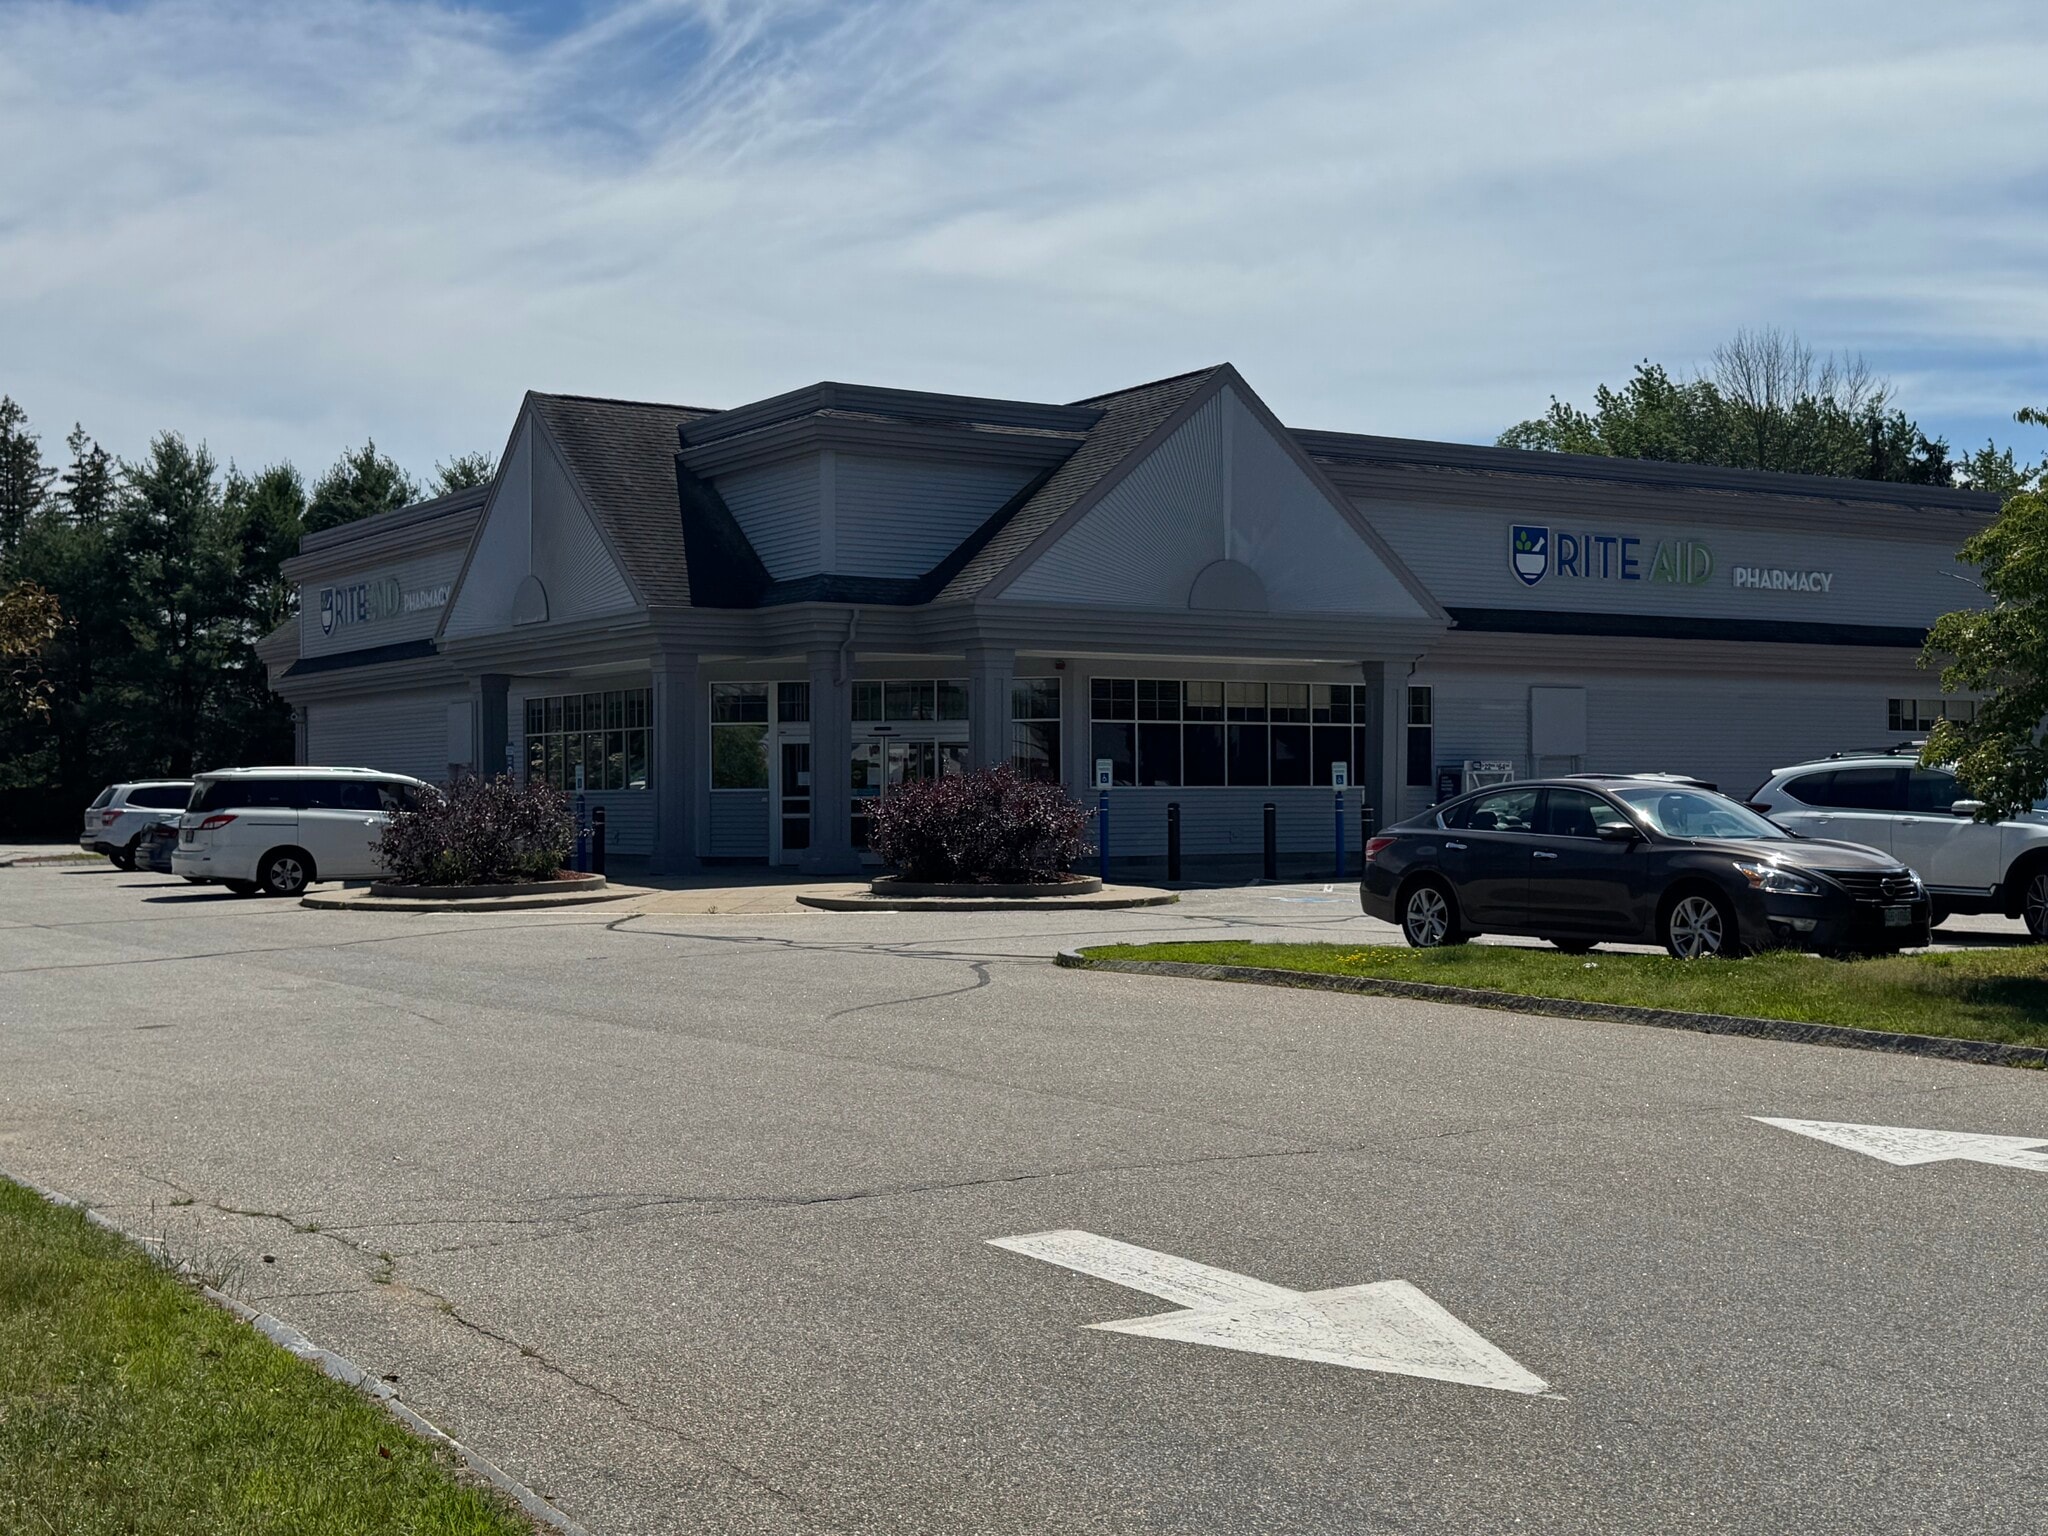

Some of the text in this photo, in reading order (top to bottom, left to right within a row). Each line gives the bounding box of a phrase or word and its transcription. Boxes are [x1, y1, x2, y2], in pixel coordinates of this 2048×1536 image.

[1553, 532, 1833, 593] RITE AID PHARMACY
[335, 578, 451, 624] RITE AID PHARMACY
